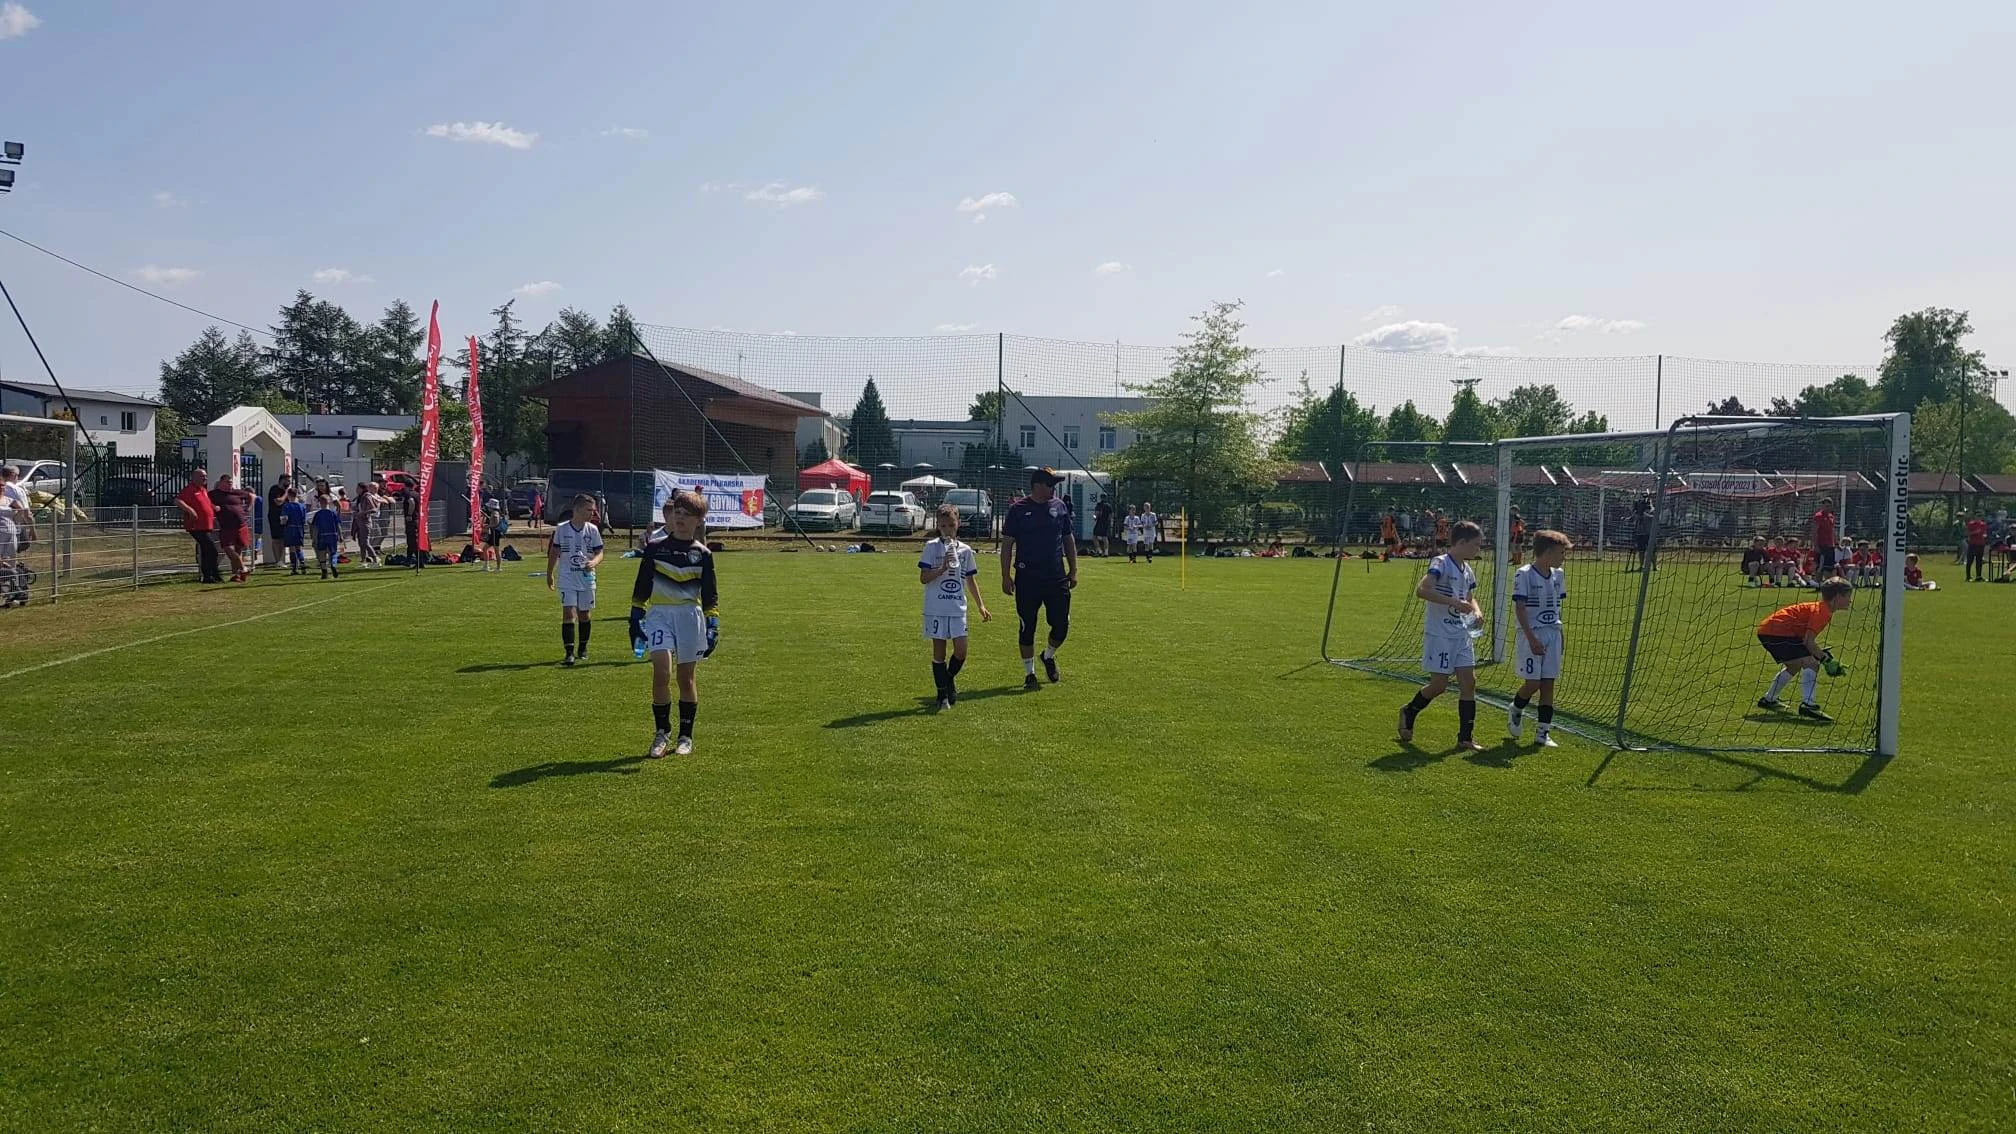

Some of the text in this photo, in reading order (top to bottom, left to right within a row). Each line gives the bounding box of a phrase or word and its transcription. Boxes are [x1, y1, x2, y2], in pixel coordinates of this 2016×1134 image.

[679, 478, 710, 486] AKADEMIA
[710, 494, 740, 511] GDYNIA
[933, 619, 939, 635] 9
[650, 629, 664, 646] 13
[1438, 652, 1449, 669] 15
[1526, 657, 1534, 674] 8
